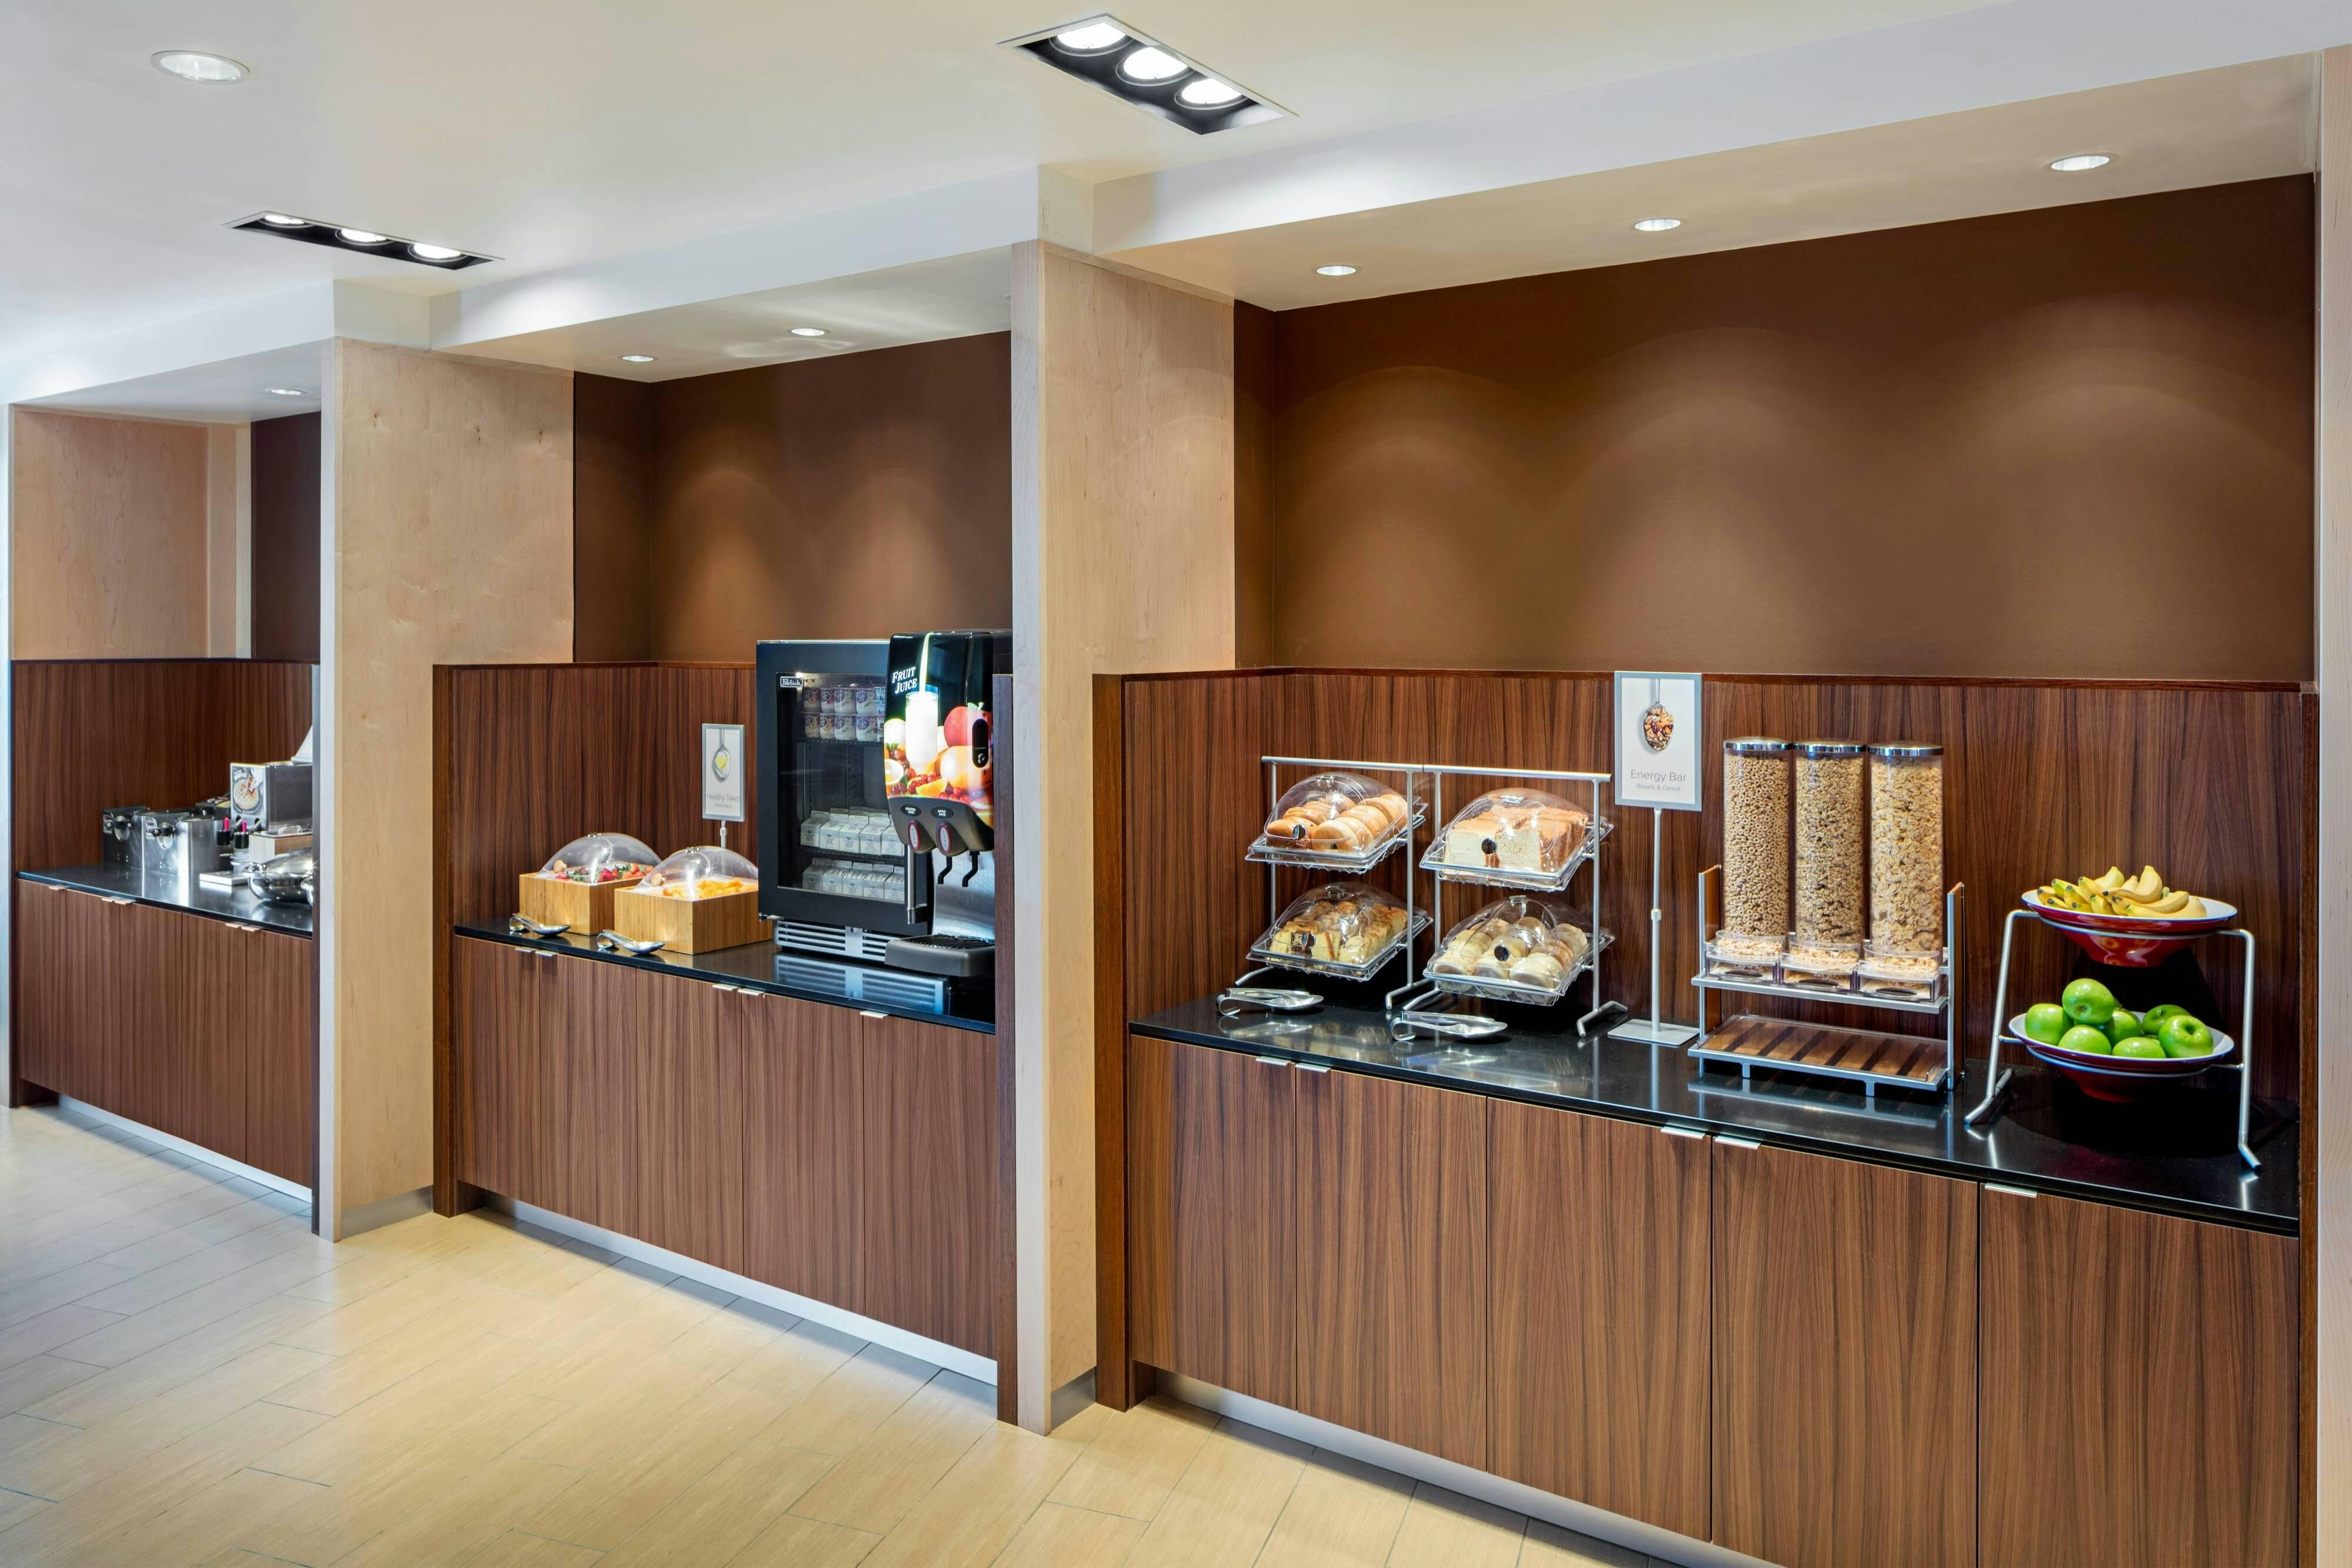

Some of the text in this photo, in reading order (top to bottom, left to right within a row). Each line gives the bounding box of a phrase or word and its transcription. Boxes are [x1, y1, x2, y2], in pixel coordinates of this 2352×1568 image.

[892, 666, 916, 684] FRUIT
[895, 678, 917, 694] JUICE
[1631, 769, 1686, 783] Energy Bar
[706, 793, 725, 803] Healthy
